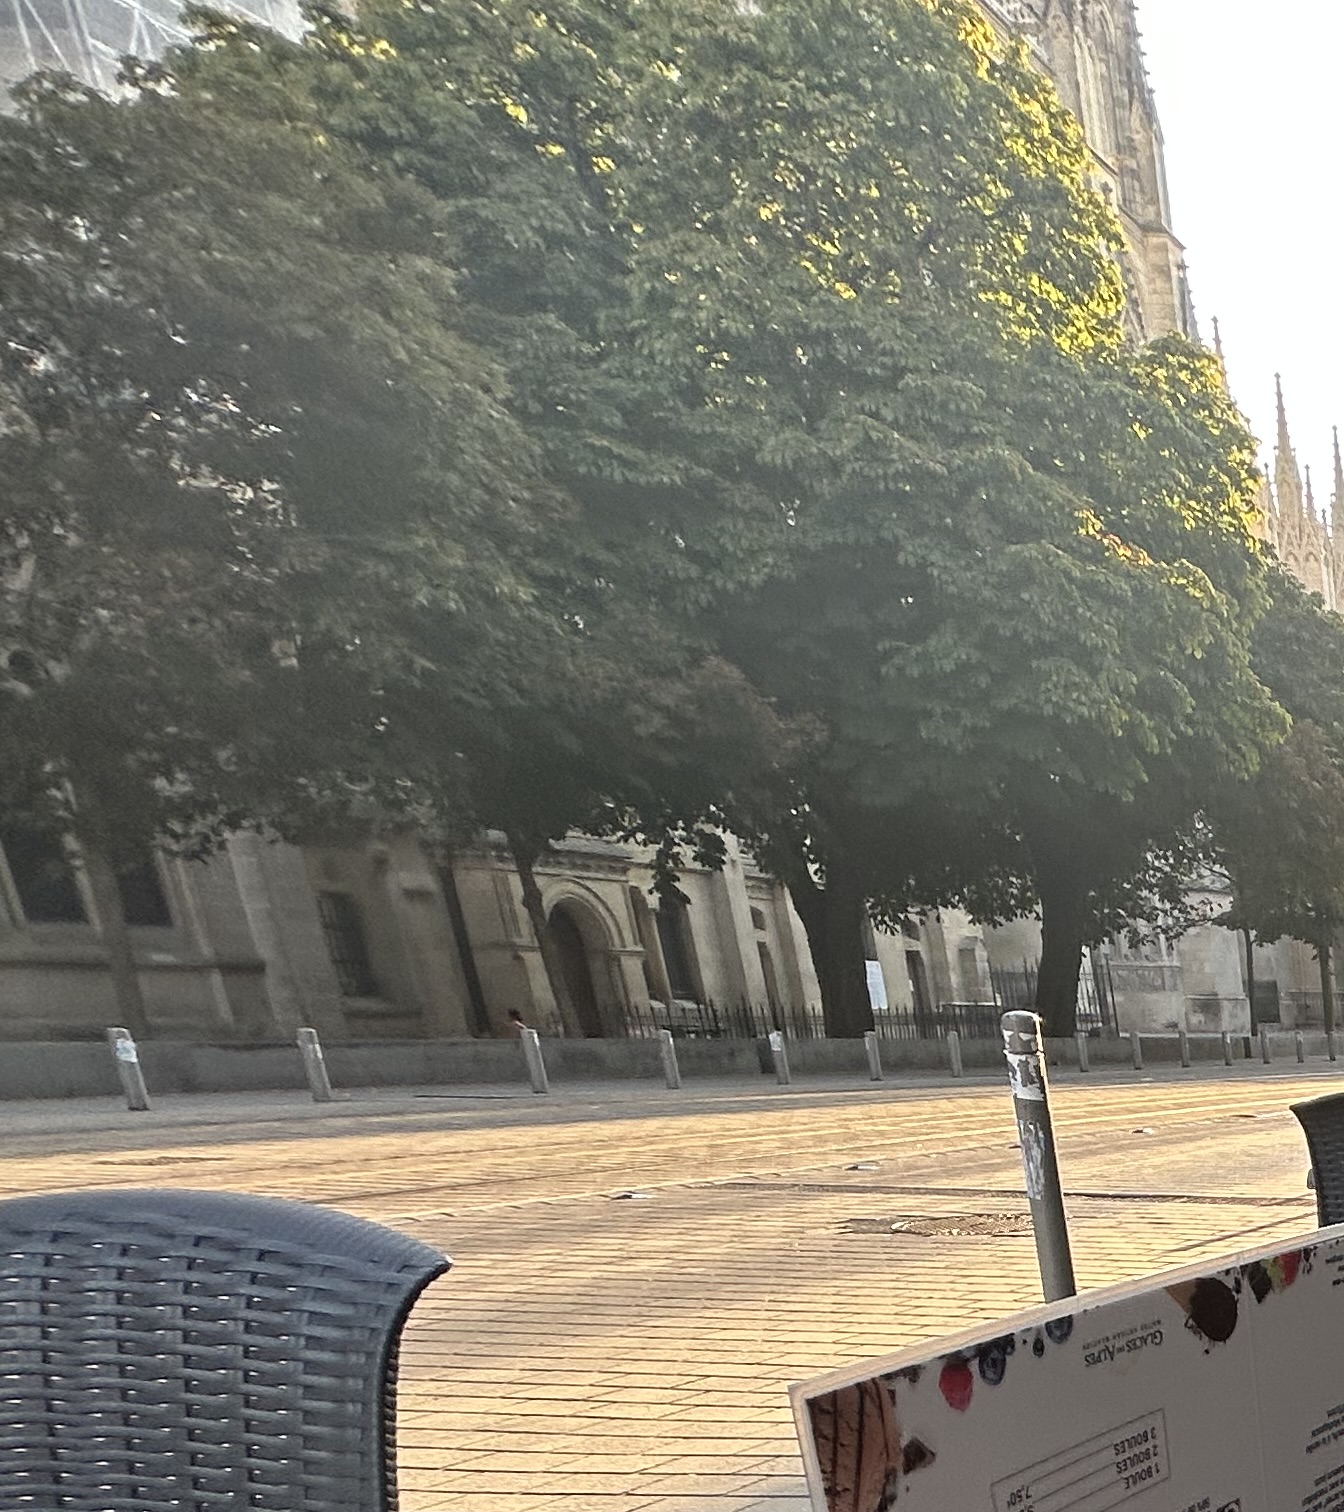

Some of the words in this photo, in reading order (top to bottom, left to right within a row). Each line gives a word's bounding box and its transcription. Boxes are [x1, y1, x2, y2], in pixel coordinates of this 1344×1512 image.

[1125, 1329, 1163, 1353] GLACES
[1084, 1344, 1115, 1367] ALPES
[1113, 1430, 1149, 1456] BOULES
[1150, 1426, 1157, 1440] 3
[1114, 1447, 1151, 1474] BOULES
[1151, 1444, 1159, 1457] 2
[1123, 1465, 1153, 1490] BOULE
[1154, 1462, 1160, 1474] 1
